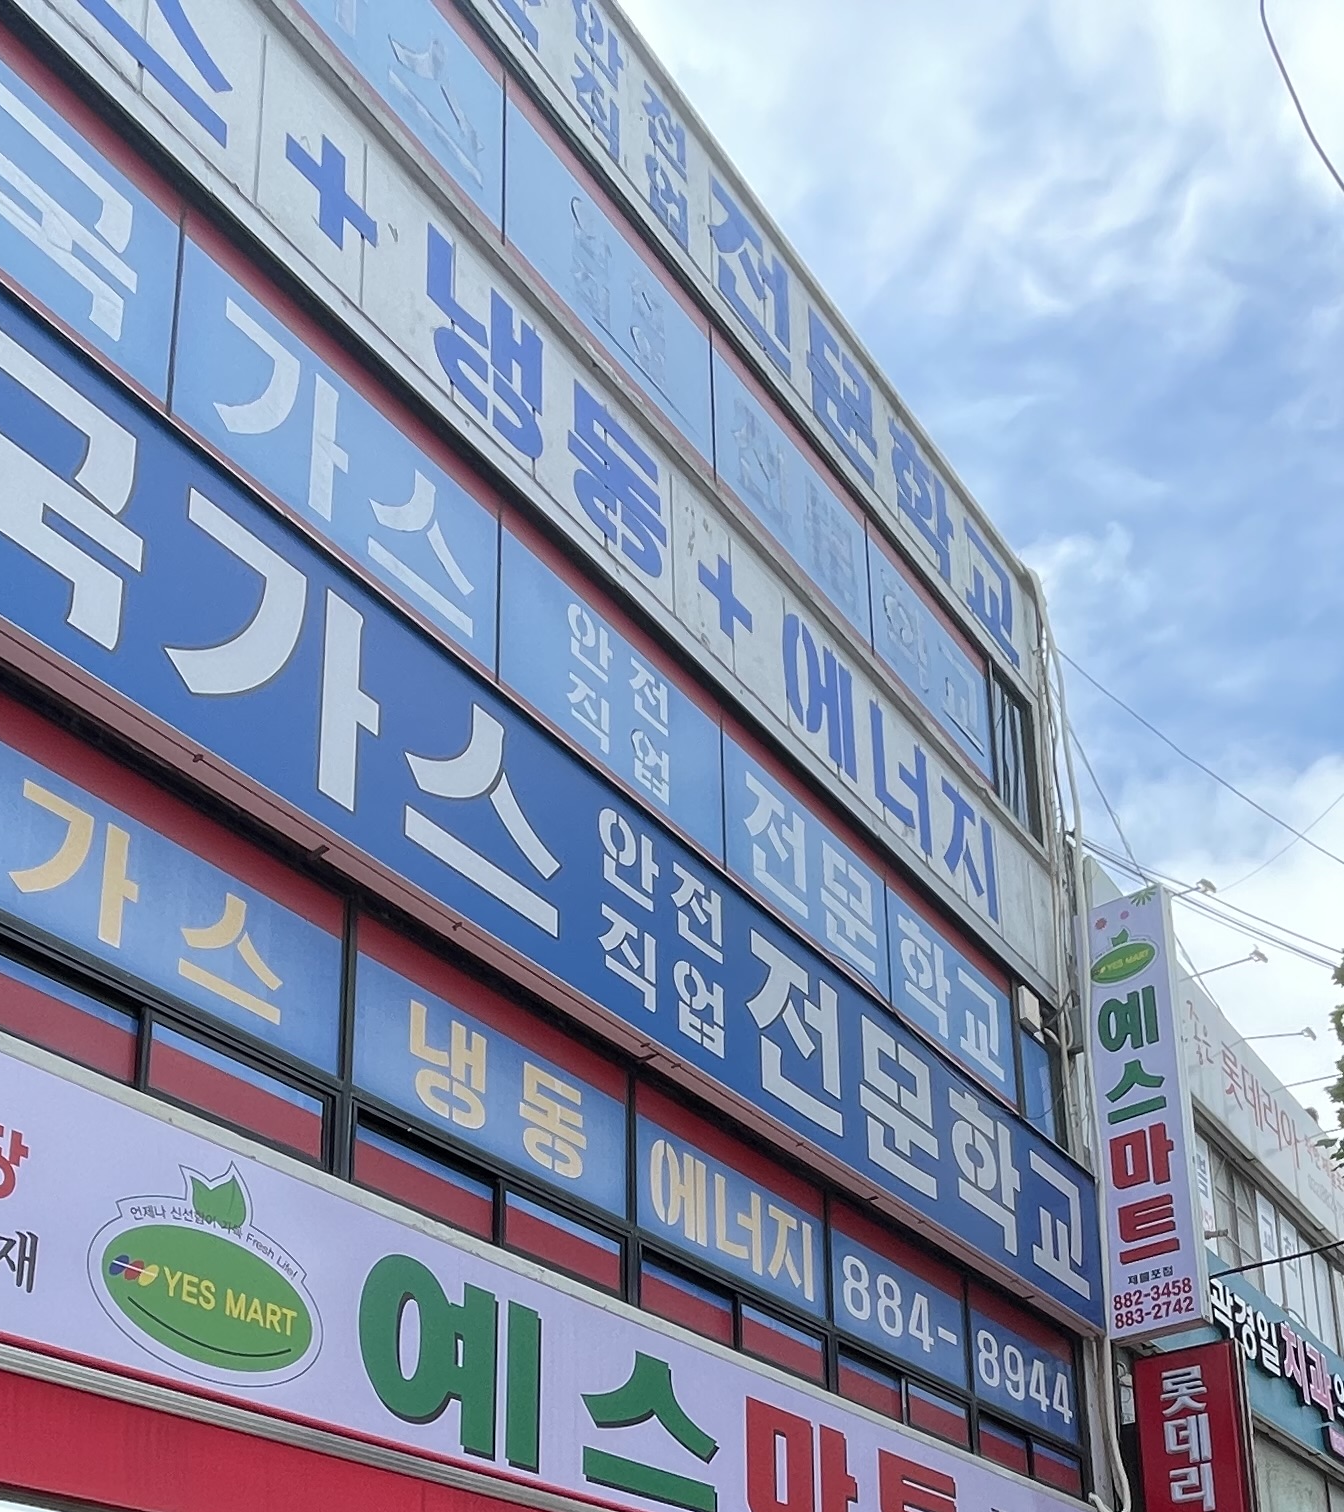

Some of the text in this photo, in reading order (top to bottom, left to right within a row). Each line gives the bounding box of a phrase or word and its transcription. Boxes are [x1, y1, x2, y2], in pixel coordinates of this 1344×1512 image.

[708, 174, 1020, 669] 전문학교
[743, 768, 1007, 1082] 전문학교
[783, 613, 1000, 926] 에너지
[9, 778, 283, 1026] 가스
[407, 1000, 587, 1181] 냉동
[649, 1139, 817, 1303] 에너지
[746, 927, 1092, 1301] 전문학교
[130, 1204, 167, 1222] 언제나
[245, 1232, 276, 1262] Fresh
[163, 1266, 298, 1337] YES MART
[1113, 1277, 1193, 1311] 882-3458
[1114, 1296, 1196, 1330] 883-2742
